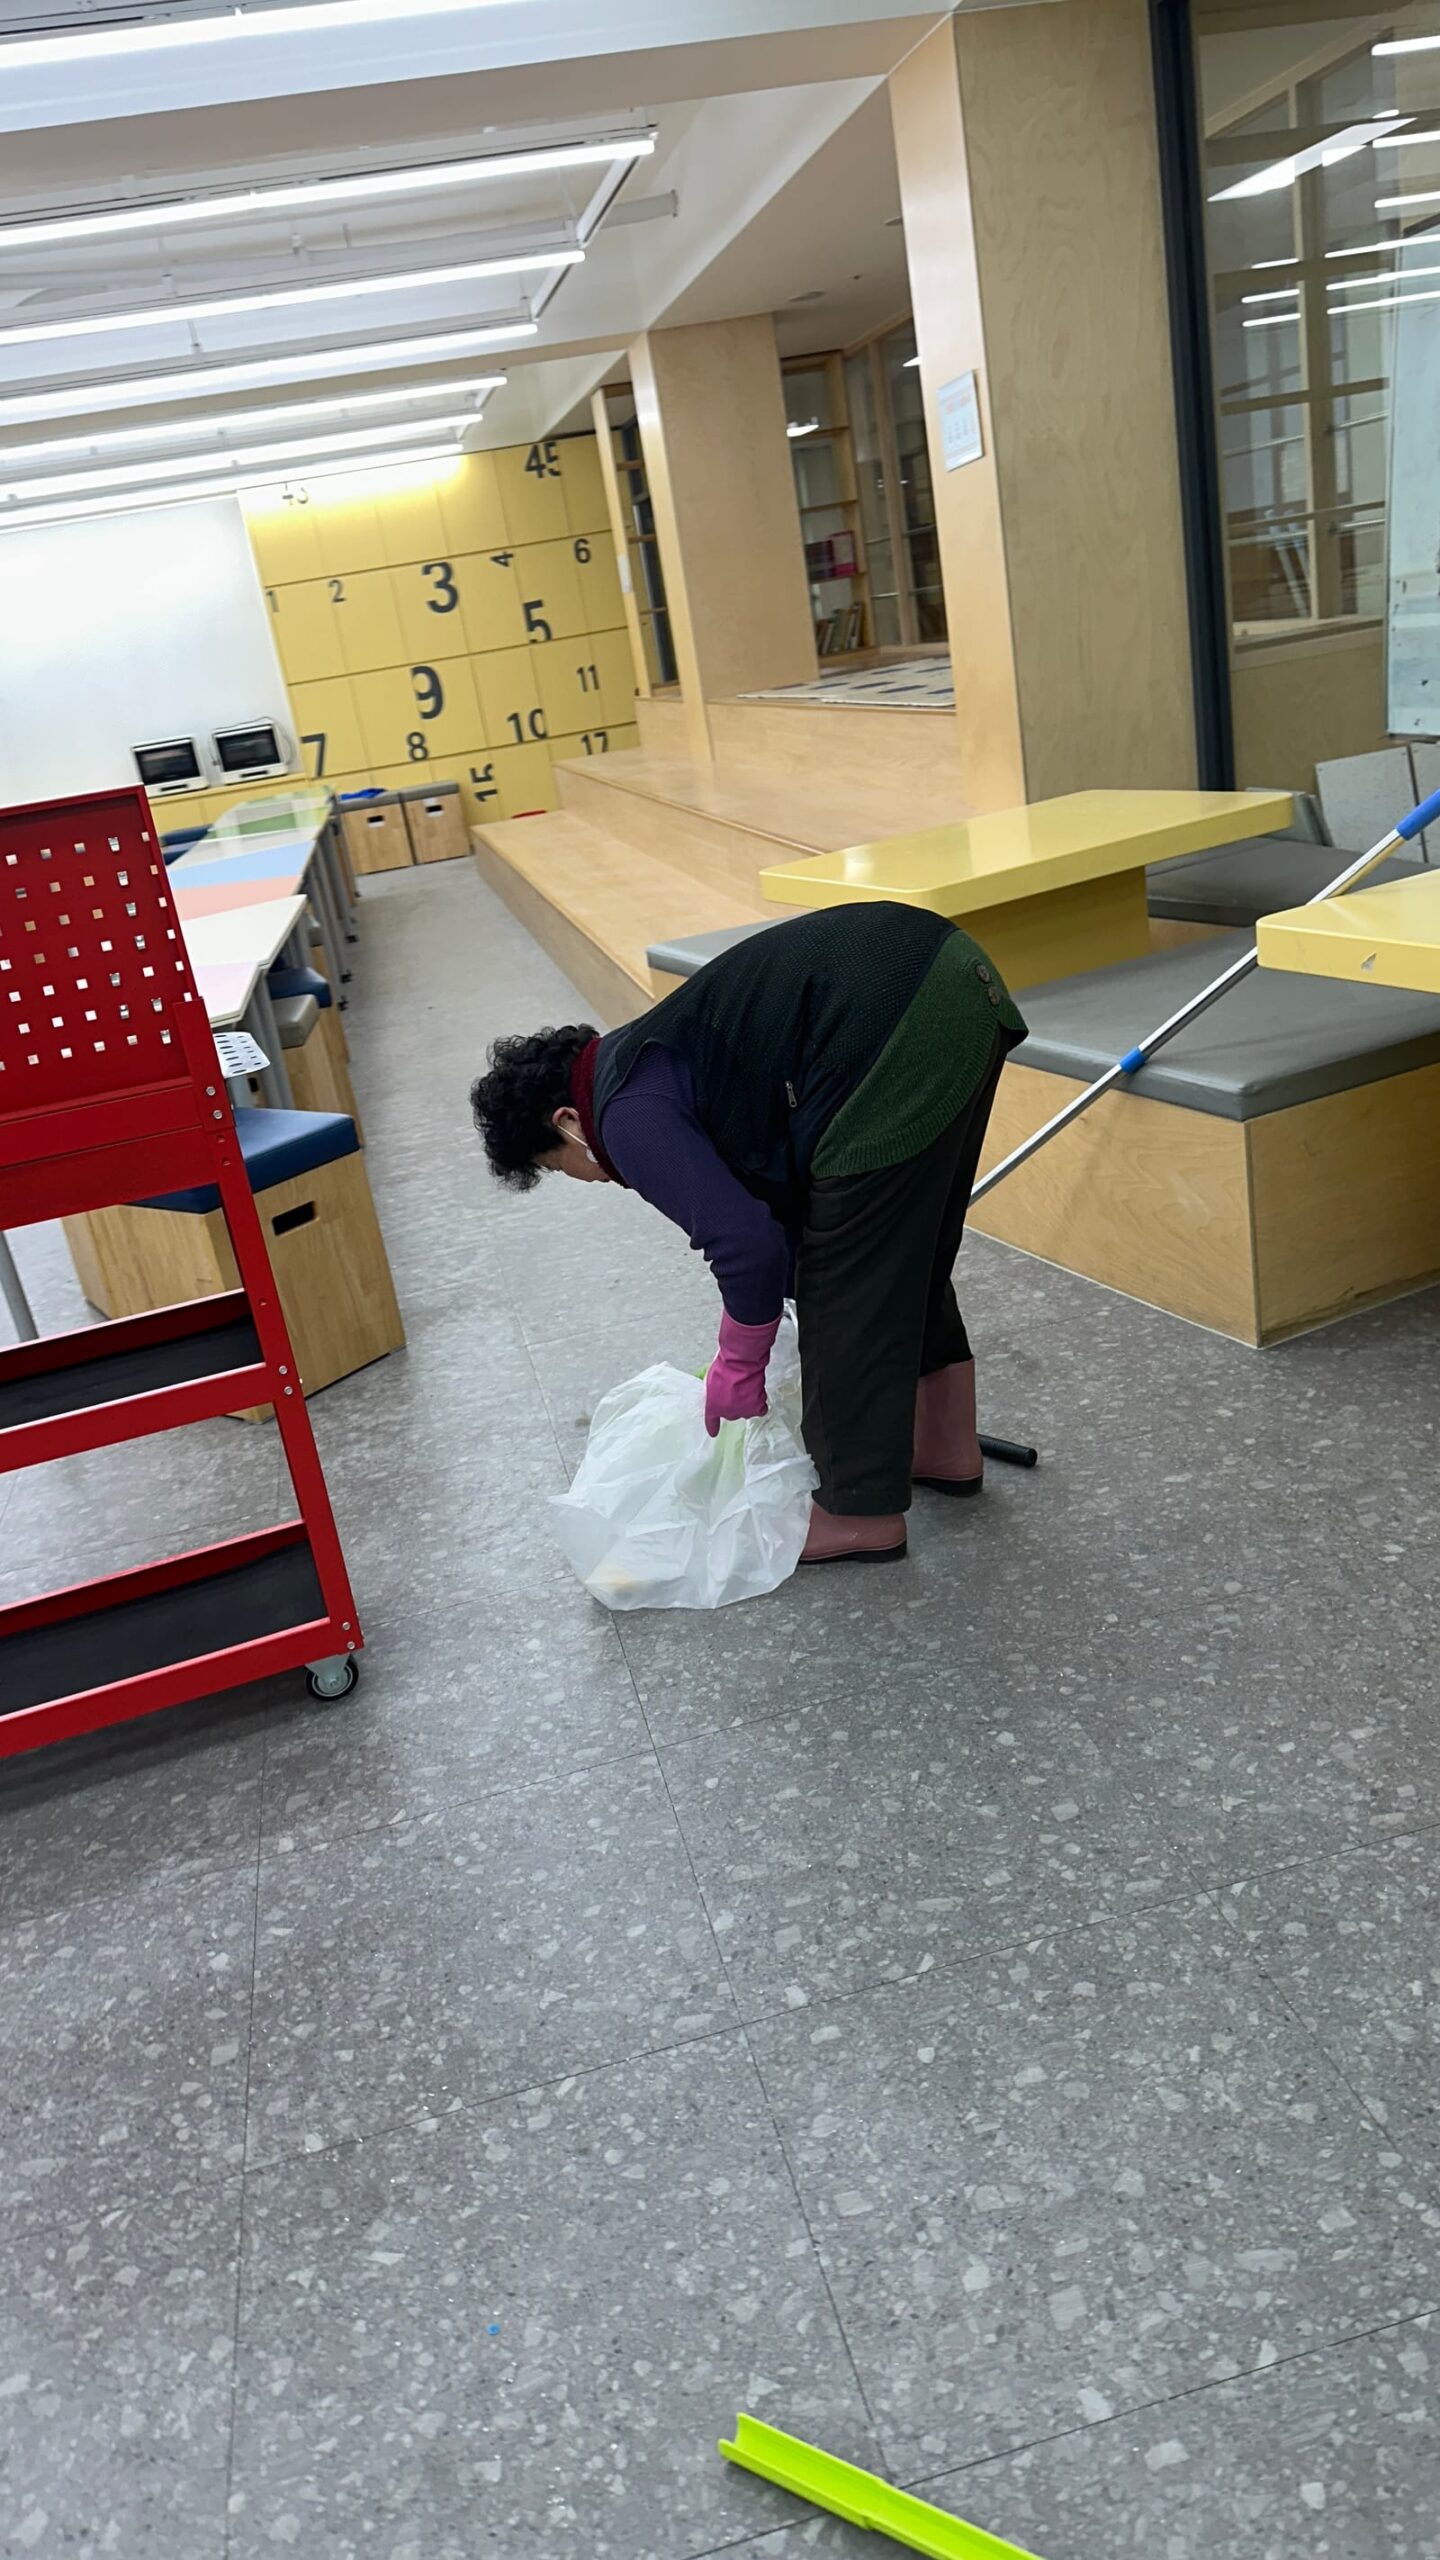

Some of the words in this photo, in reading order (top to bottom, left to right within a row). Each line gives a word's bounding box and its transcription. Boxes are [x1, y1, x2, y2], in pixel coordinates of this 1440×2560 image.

[490, 551, 513, 567] 4
[574, 538, 591, 564] 6
[265, 590, 280, 613] 1
[327, 579, 347, 603] 2
[422, 562, 459, 613] 3
[523, 599, 552, 643] 5
[410, 665, 444, 720] 9
[576, 665, 600, 692] 11
[507, 708, 547, 744] 10
[300, 733, 326, 778] 7
[406, 731, 428, 761] 8
